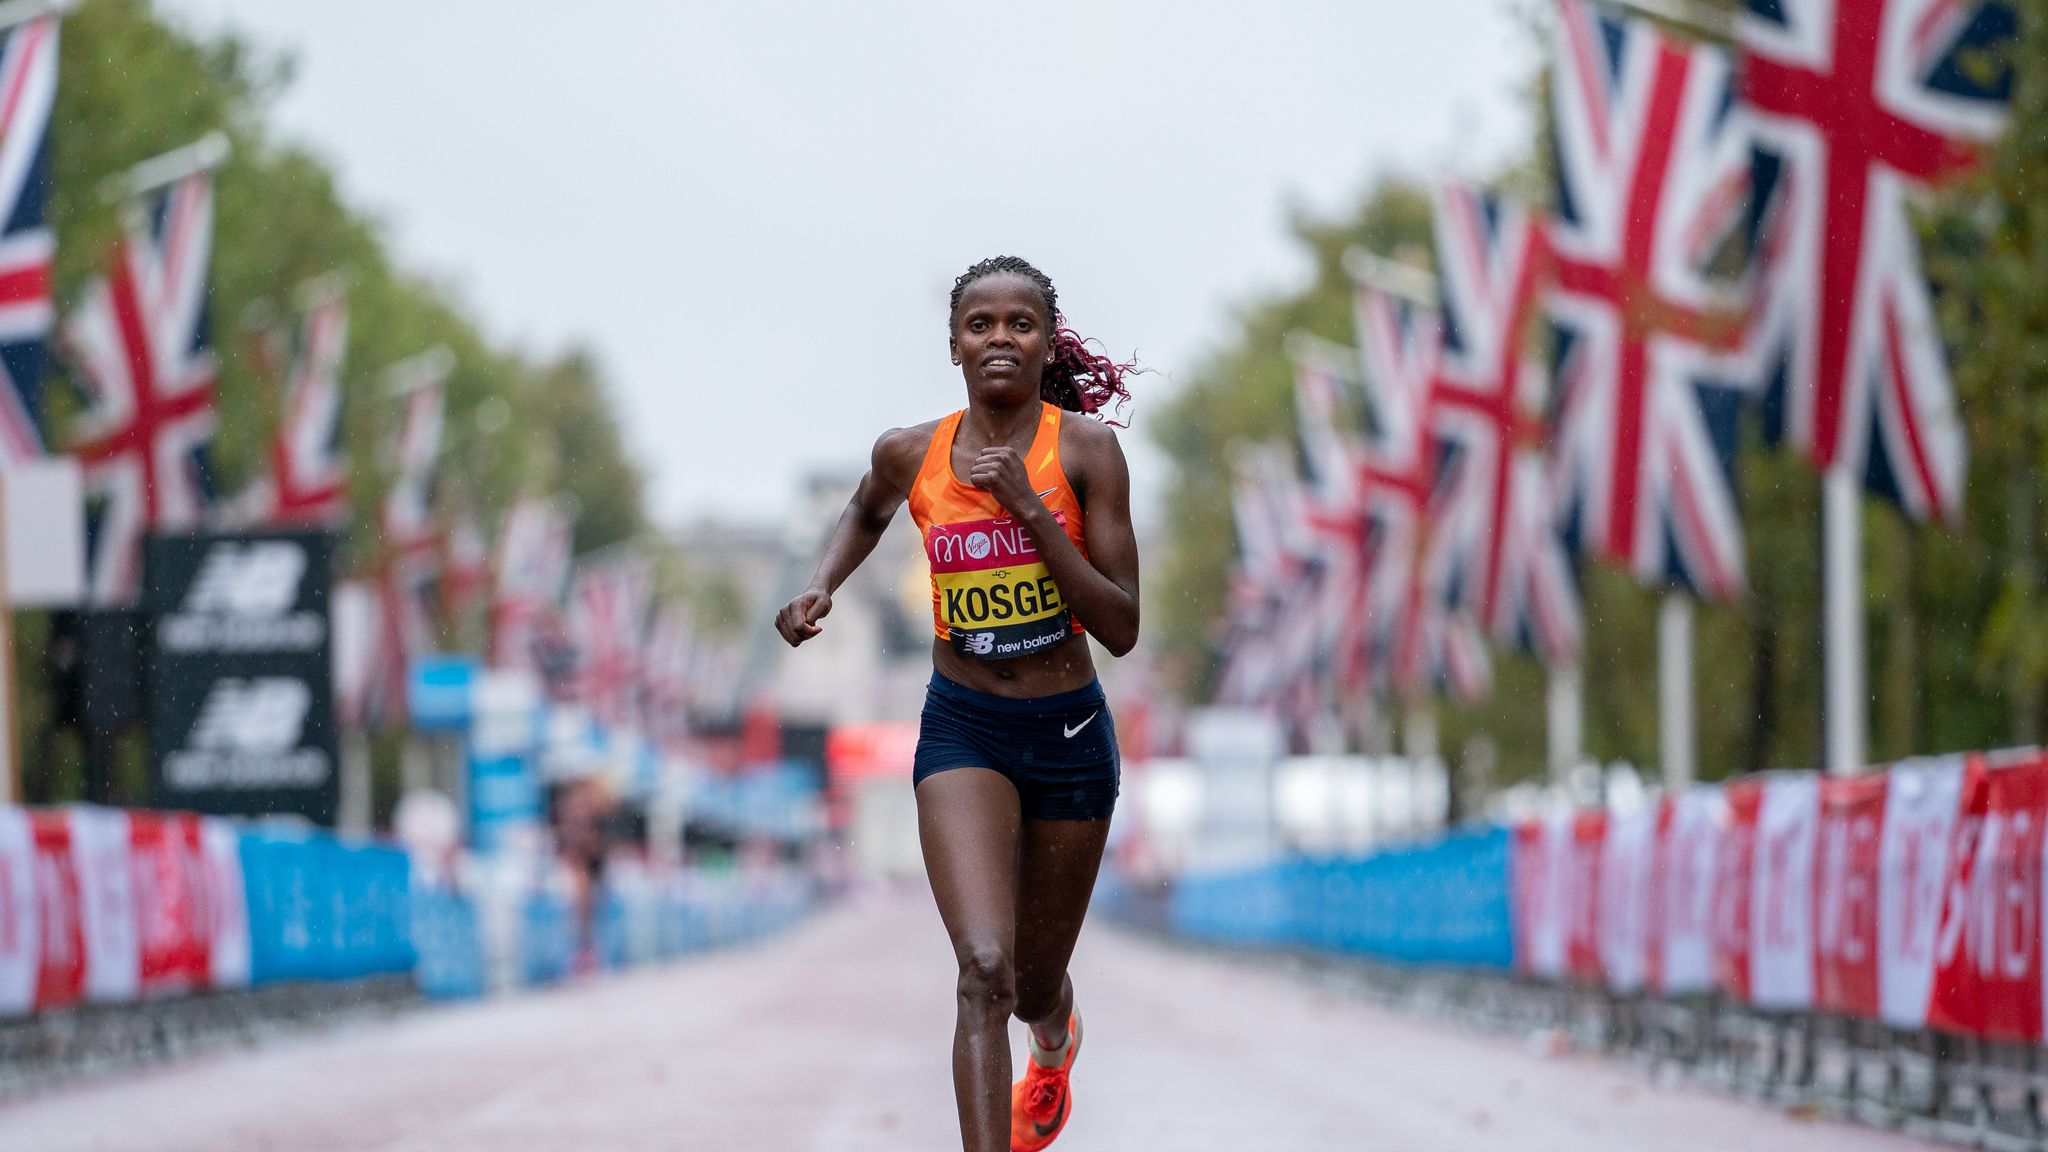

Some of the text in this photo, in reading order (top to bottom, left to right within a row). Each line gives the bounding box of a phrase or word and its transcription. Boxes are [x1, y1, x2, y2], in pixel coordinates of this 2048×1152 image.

[967, 535, 989, 555] Virgin
[946, 575, 1066, 624] KOSGE
[997, 642, 1021, 653] new
[1023, 628, 1065, 649] balance
